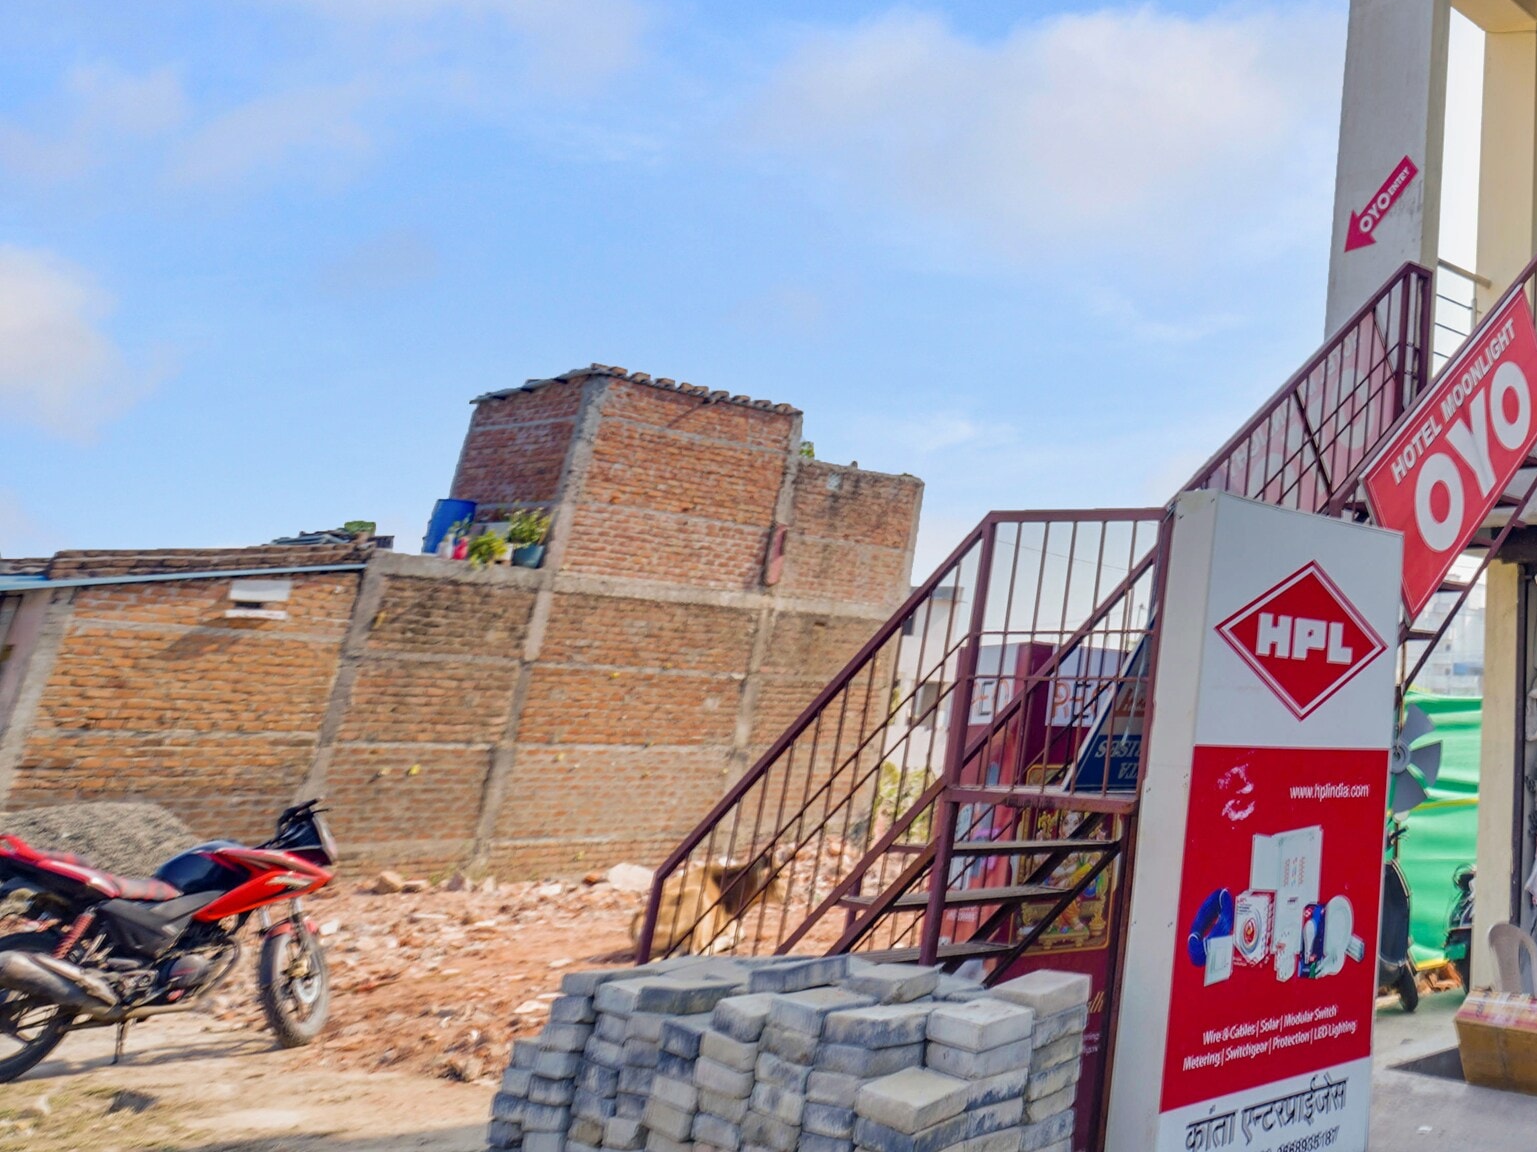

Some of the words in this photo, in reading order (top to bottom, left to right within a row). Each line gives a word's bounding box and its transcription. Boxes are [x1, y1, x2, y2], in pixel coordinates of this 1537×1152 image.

[1360, 192, 1390, 233] OYO
[1387, 166, 1410, 196] ENTRY
[1390, 413, 1442, 485] HOTEL
[1441, 318, 1517, 416] MOONLIGHT
[1415, 361, 1532, 552] OYO
[1255, 611, 1353, 665] HPL
[1289, 782, 1370, 801] www.hplindia.com
[1182, 1053, 1221, 1072] Metering
[1225, 1041, 1269, 1063] Switchgear
[1272, 1030, 1310, 1049] Protection
[1313, 1026, 1329, 1041] LED
[1328, 1019, 1358, 1039] Lighting
[1202, 1030, 1221, 1046] Wire
[1229, 1023, 1257, 1040] Cables
[1260, 1017, 1280, 1034] Solar
[1283, 1009, 1314, 1028] Modular
[1313, 1004, 1338, 1021] Switch
[1185, 1104, 1239, 1152] कांता
